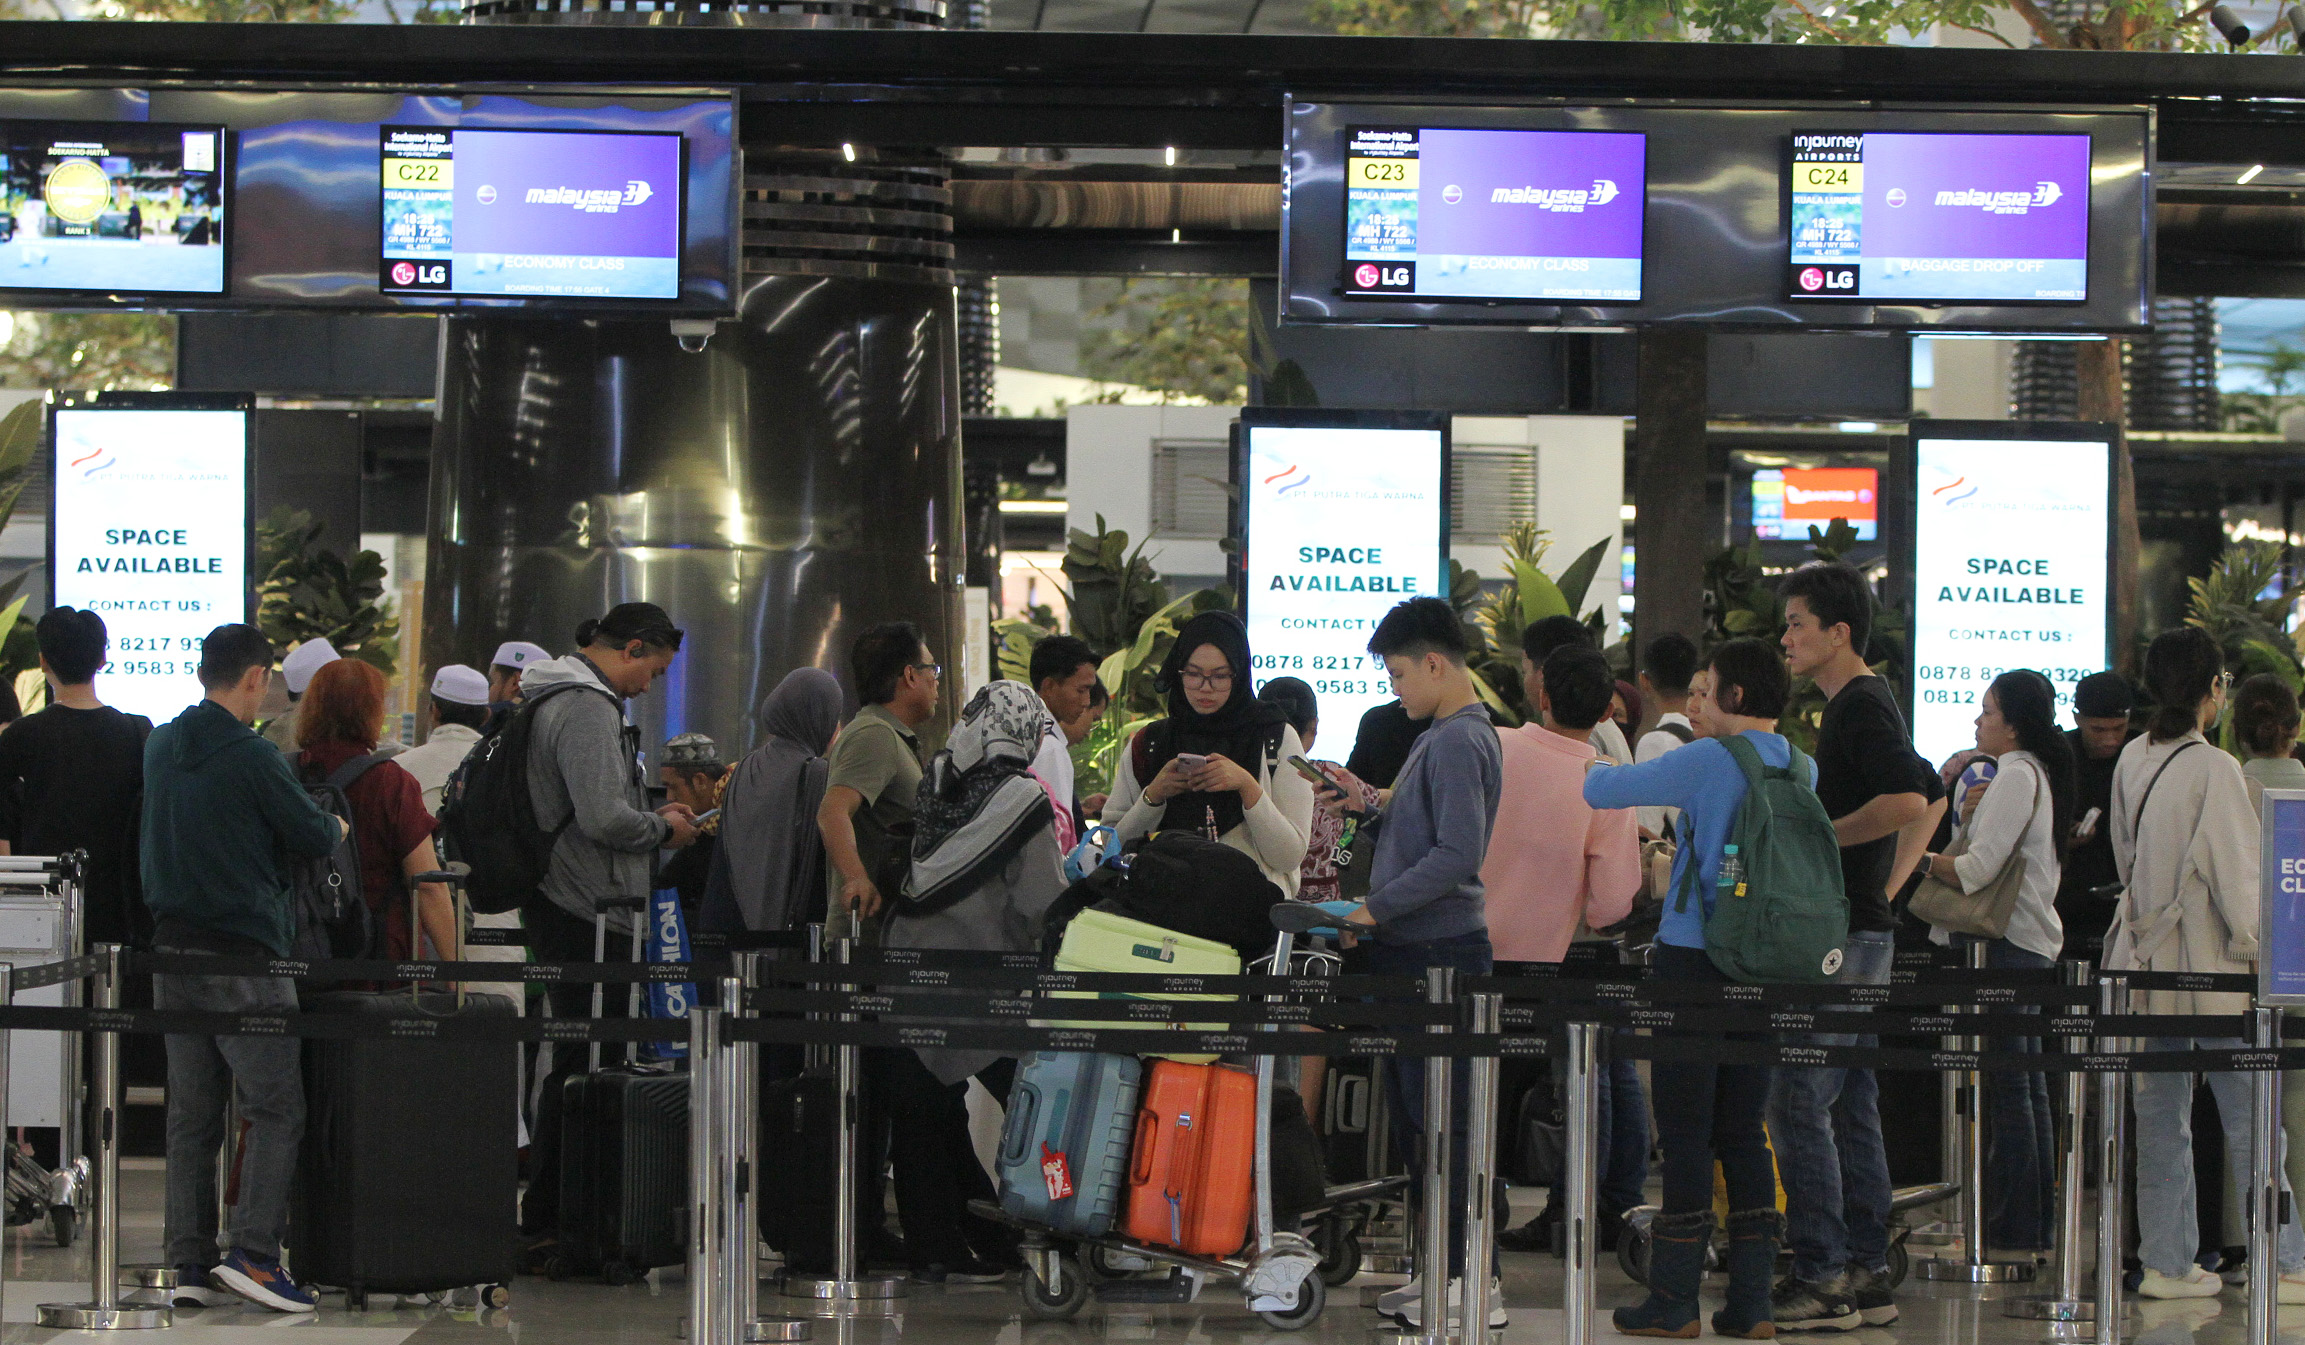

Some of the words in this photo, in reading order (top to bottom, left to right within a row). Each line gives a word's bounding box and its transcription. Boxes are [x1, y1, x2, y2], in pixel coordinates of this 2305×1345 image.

[1794, 136, 1864, 152] injourney
[1796, 152, 1860, 162] AIRPORTS
[399, 164, 439, 181] C22
[1364, 164, 1404, 180] C23
[1808, 168, 1848, 185] C24
[384, 191, 414, 200] KUALA
[415, 192, 452, 201] LUMPUR
[525, 186, 622, 210] malaysia
[1350, 192, 1380, 200] KUALA
[1380, 192, 1417, 201] LUMPUR
[1490, 186, 1588, 209] malaysia
[1794, 196, 1824, 204] KUALA
[1825, 196, 1862, 205] LUMPUR
[1934, 188, 2032, 212] malaysia
[394, 223, 416, 236] MH
[419, 225, 443, 237] 722
[1358, 225, 1380, 237] MH
[1384, 226, 1408, 238] 722
[1802, 229, 1824, 240] MH
[1828, 229, 1852, 241] 722
[504, 255, 576, 269] ECONOMY
[579, 258, 625, 271] CLASS
[1468, 256, 1540, 270] ECONOMY
[1544, 258, 1590, 272] CLASS
[1900, 259, 1970, 272] BAGGAGE
[1973, 260, 2014, 272] DROP
[2016, 260, 2045, 272] OFF
[418, 265, 446, 284] LG
[1382, 267, 1410, 286] LG
[1826, 270, 1854, 289] LG
[1314, 490, 1350, 498] PUTRA
[1383, 492, 1424, 500] WARNA
[106, 529, 188, 546] SPACE
[1298, 546, 1382, 564] SPACE
[76, 557, 223, 574] AVAILABLE
[1966, 558, 2049, 576] SPACE
[1269, 575, 1418, 594] AVAILABLE
[1938, 586, 2084, 604] AVAILABLE
[88, 600, 171, 612] CONTACT
[178, 600, 200, 612] US
[1281, 618, 1365, 630] CONTACT
[1949, 628, 2032, 642] CONTACT
[2039, 630, 2062, 642] US
[120, 637, 171, 651] 8217
[124, 661, 174, 675] 9583
[1252, 654, 1304, 669] 0878
[1312, 656, 1364, 670] 8217
[1920, 665, 1971, 680] 0878
[1316, 680, 1367, 694] 9583
[1924, 690, 1975, 704] 0812
[884, 950, 921, 959] injourney
[270, 960, 310, 970] injourney
[397, 964, 436, 973] injourney
[522, 965, 562, 974] injourney
[649, 965, 689, 974] injourney
[909, 970, 949, 979] injourney
[1038, 974, 1077, 984] injourney
[2177, 974, 2214, 984] injourney
[1164, 977, 1204, 987] injourney
[1290, 979, 1330, 989] injourney
[1596, 984, 1636, 993] injourney
[1723, 986, 1763, 995] injourney
[1851, 988, 1890, 997] injourney
[1976, 988, 2016, 997] injourney
[850, 996, 893, 1005] injourney
[1128, 1003, 1173, 1014] injourney
[1267, 1005, 1311, 1015] injourney
[1631, 1010, 1675, 1020] injourney
[1771, 1012, 1815, 1022] injourney
[1910, 1016, 1954, 1025] injourney
[2051, 1018, 2095, 1028] injourney
[1780, 1047, 1828, 1057] injourney
[2232, 1052, 2279, 1062] injourney
[2082, 1056, 2130, 1065] injourney
